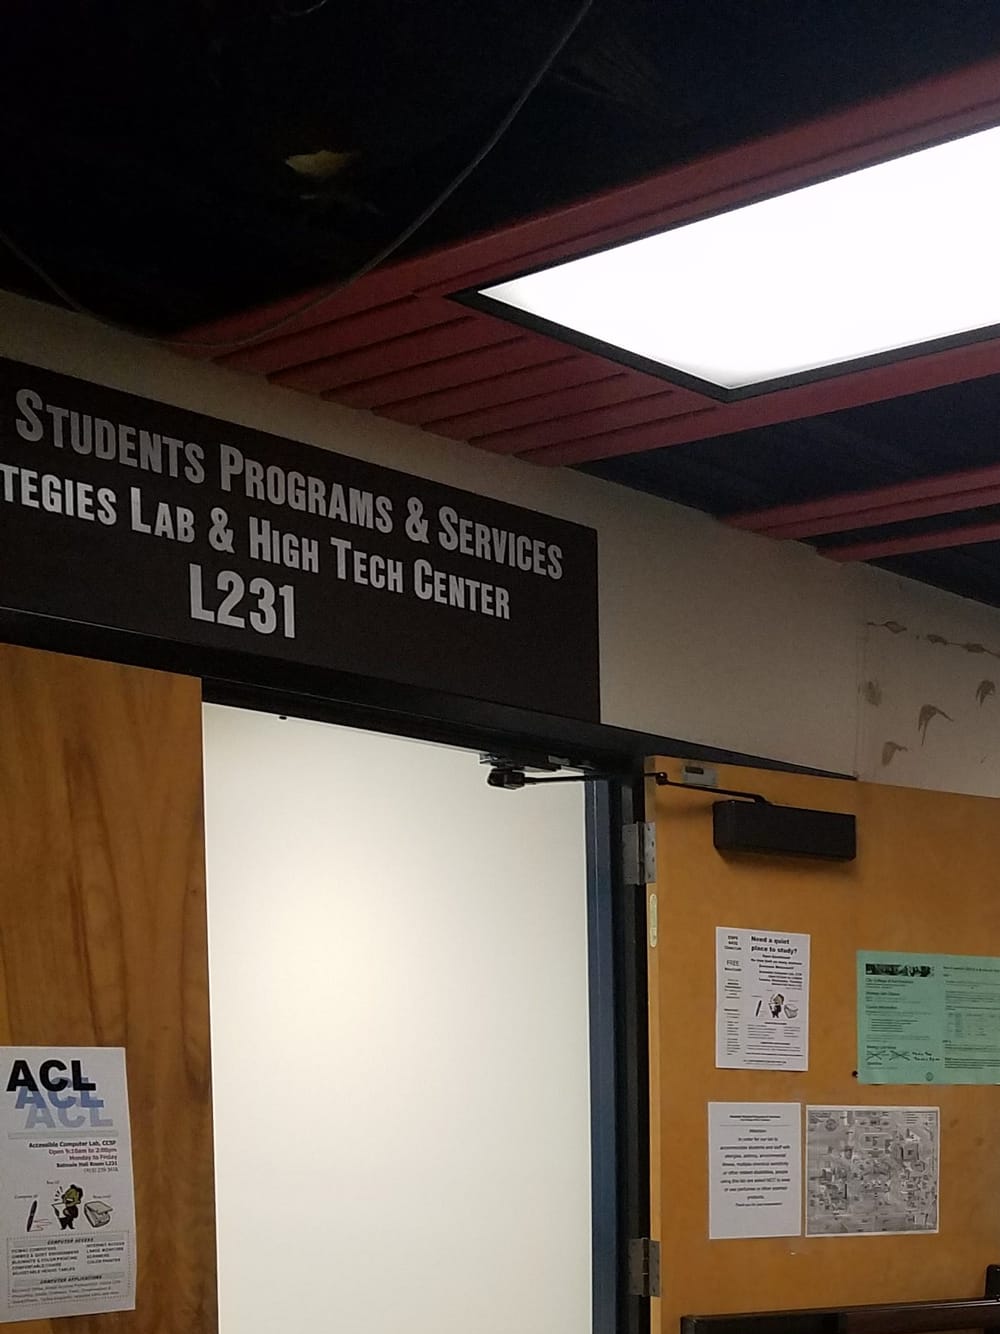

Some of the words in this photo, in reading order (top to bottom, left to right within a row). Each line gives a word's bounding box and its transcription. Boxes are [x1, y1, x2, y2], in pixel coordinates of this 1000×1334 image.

[0, 462, 117, 526] TEGIES
[130, 486, 195, 543] LAB
[208, 507, 235, 554] &
[249, 516, 320, 574] HIGH
[330, 536, 404, 594] TECH
[413, 558, 510, 620] CENTER
[16, 388, 205, 484] STUDENTS
[220, 443, 393, 534] PROGRAMS
[405, 496, 430, 544] &
[438, 506, 563, 580] SERVICES
[189, 563, 296, 638] L231
[6, 1059, 97, 1092] ACL
